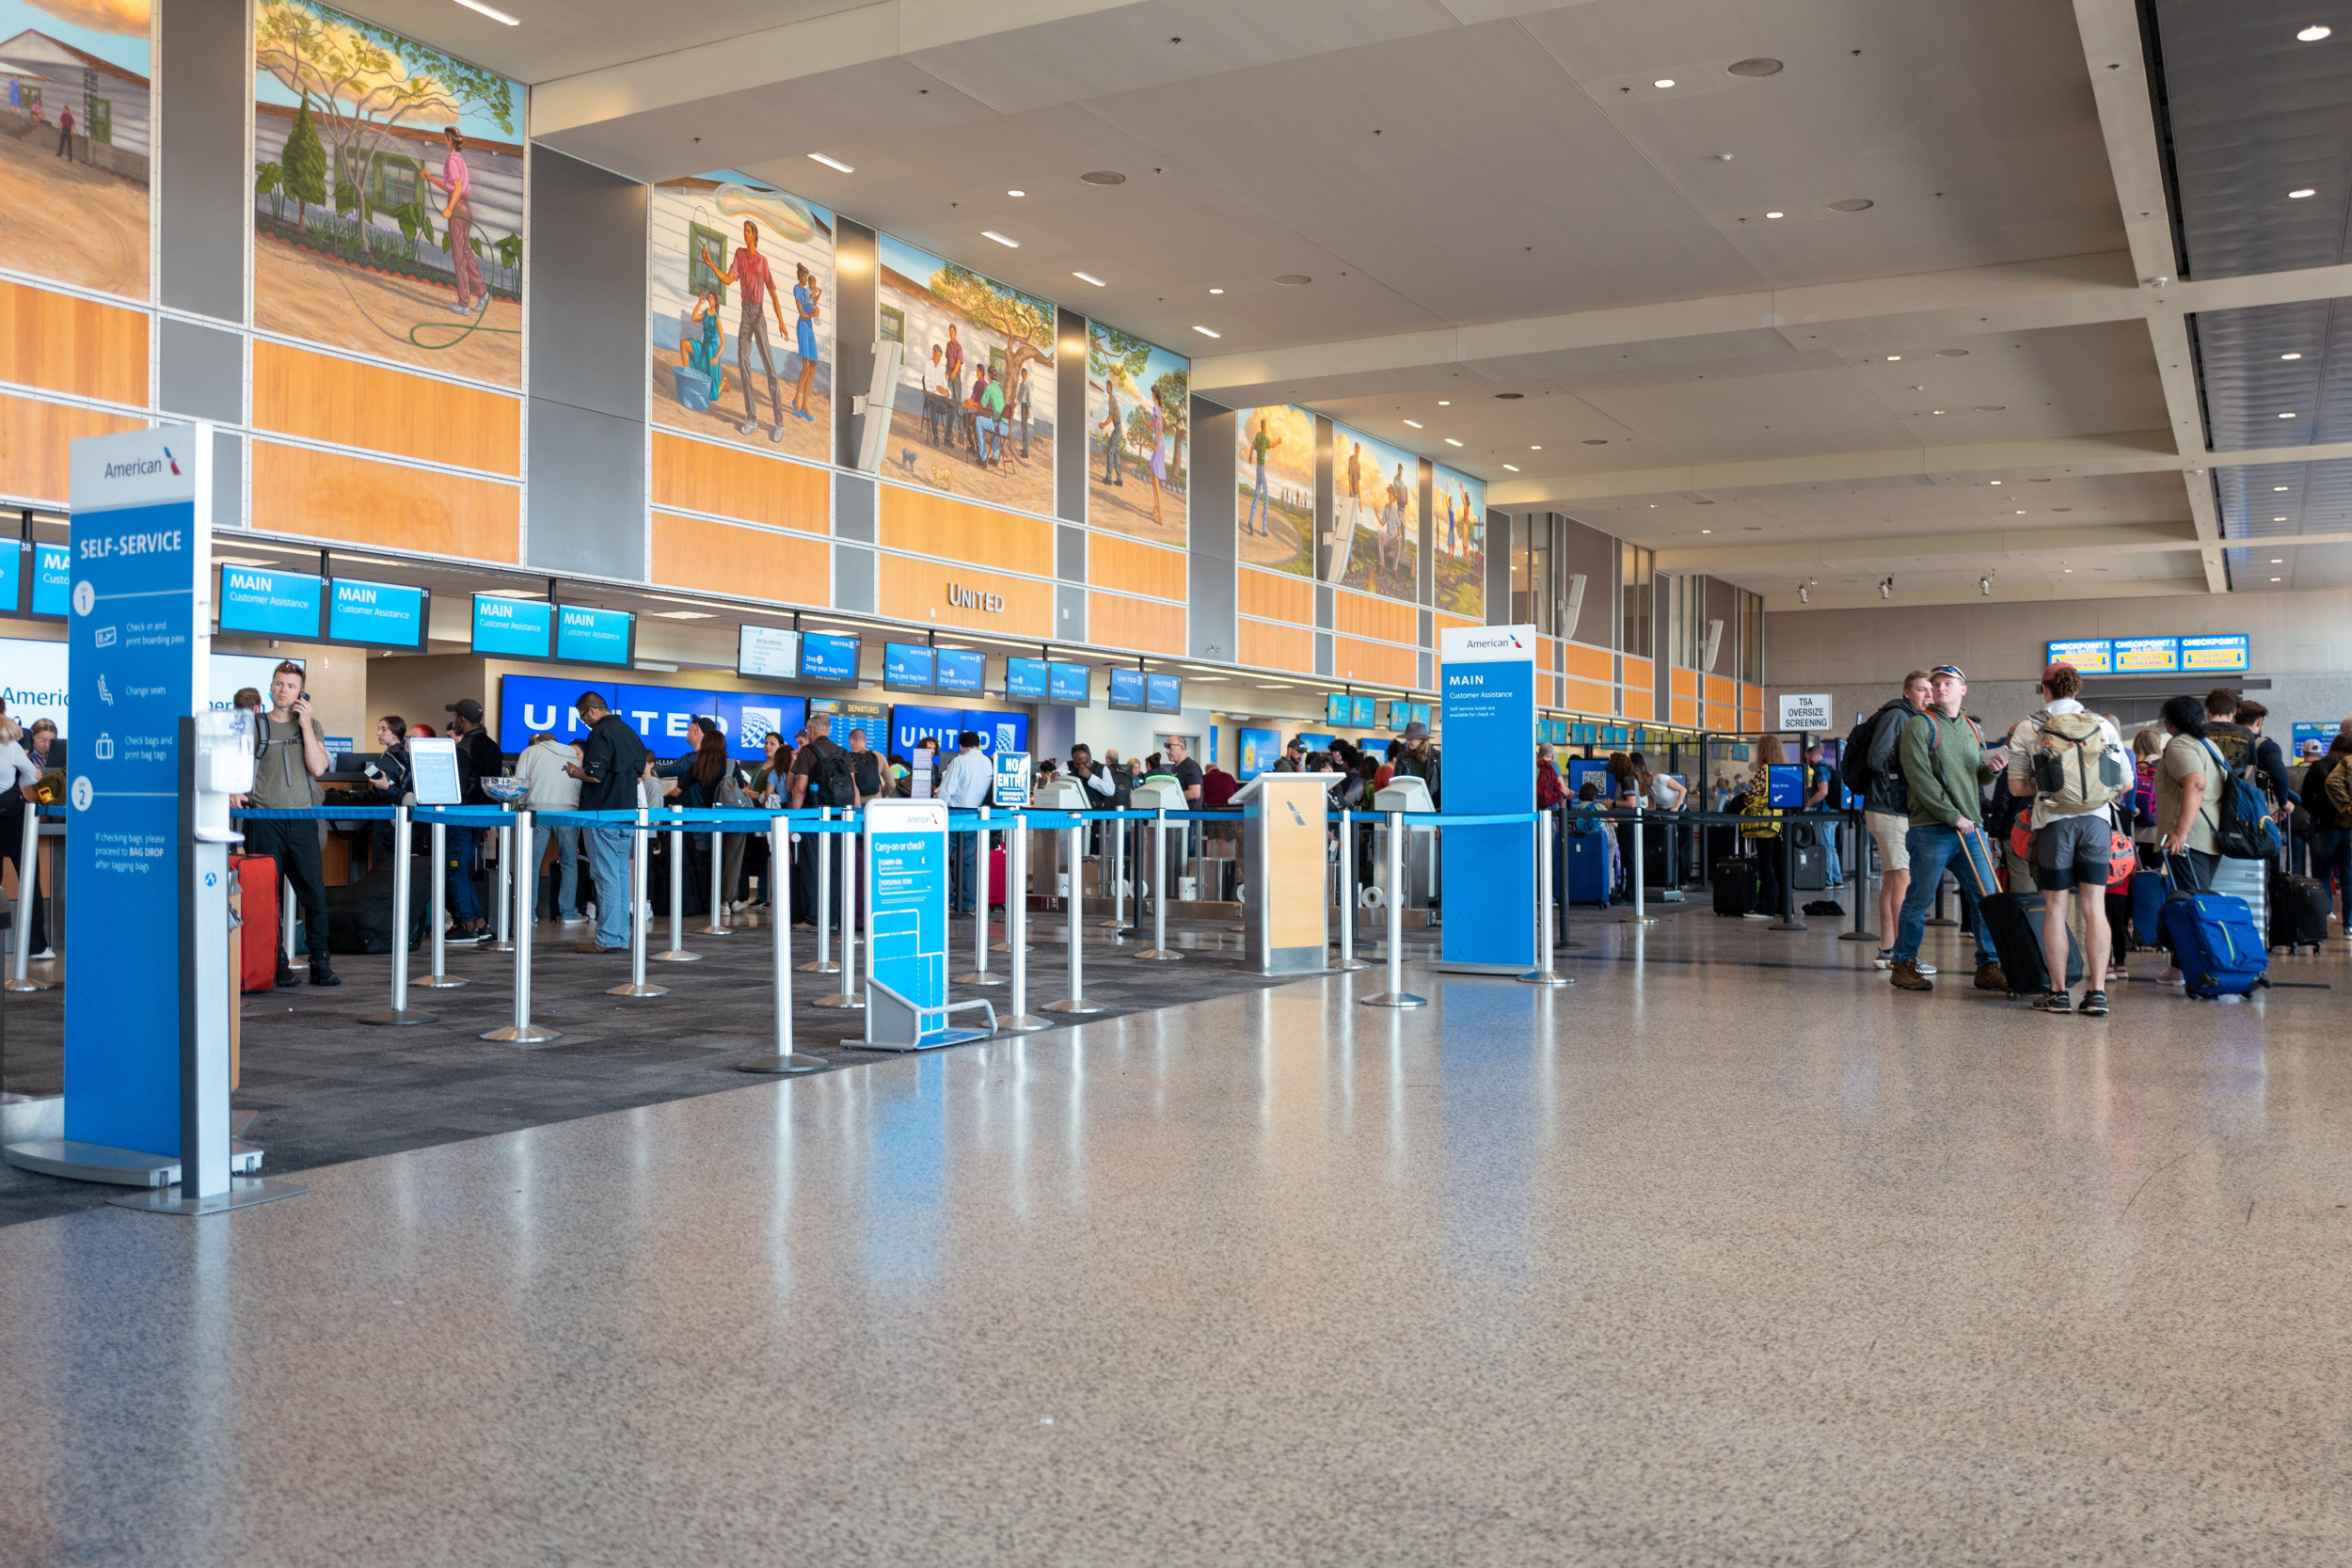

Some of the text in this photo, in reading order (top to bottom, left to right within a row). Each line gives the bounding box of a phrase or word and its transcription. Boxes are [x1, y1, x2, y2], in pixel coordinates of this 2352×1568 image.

[104, 457, 162, 480] American
[21, 543, 32, 552] 38
[80, 531, 182, 560] SELF-SERVICE
[43, 553, 70, 571] MA
[42, 573, 70, 585] Custo
[230, 574, 272, 592] MAIN
[321, 578, 329, 587] 36
[230, 592, 310, 610] Customer Assistance
[338, 587, 376, 604] MAIN
[948, 582, 1005, 613] UNITED
[338, 604, 410, 620] Customer Assistance
[481, 603, 513, 618] MAIN
[550, 604, 557, 612] 34
[154, 621, 167, 631] and
[480, 618, 542, 633] Customer Assistance
[564, 613, 595, 627] MAIN
[564, 628, 621, 641] Customer Assistance
[126, 635, 185, 648] print boarding pass
[1467, 639, 1509, 649] American
[2050, 641, 2104, 651] CHECKPOINT
[2115, 639, 2177, 649] CHECKPOINT 3
[2182, 637, 2246, 647] CHECKPOINT 3
[805, 664, 818, 673] Drop
[828, 666, 837, 674] bag
[1449, 674, 1484, 686] MAIN
[3, 687, 70, 706] Ameri
[125, 686, 167, 698] Change seats
[1799, 698, 1813, 706] TSA
[848, 705, 880, 714] DEPARTURES
[1788, 708, 1824, 717] OVERSIZE
[524, 704, 728, 736] UNTED
[1785, 719, 1827, 727] SCREENING
[125, 736, 173, 748] Check bags and
[900, 726, 991, 751] UNITD
[125, 750, 167, 762] print bag tags
[1006, 758, 1020, 772] NO
[997, 773, 1026, 788] ENTRY
[79, 790, 86, 805] 2
[95, 833, 100, 843] If
[101, 832, 128, 845] checking
[145, 833, 166, 845] please
[95, 847, 164, 858] proceed to BAG DROP
[875, 842, 899, 854] Carry-on
[906, 840, 925, 850] check?
[95, 860, 150, 874] after tagging bags
